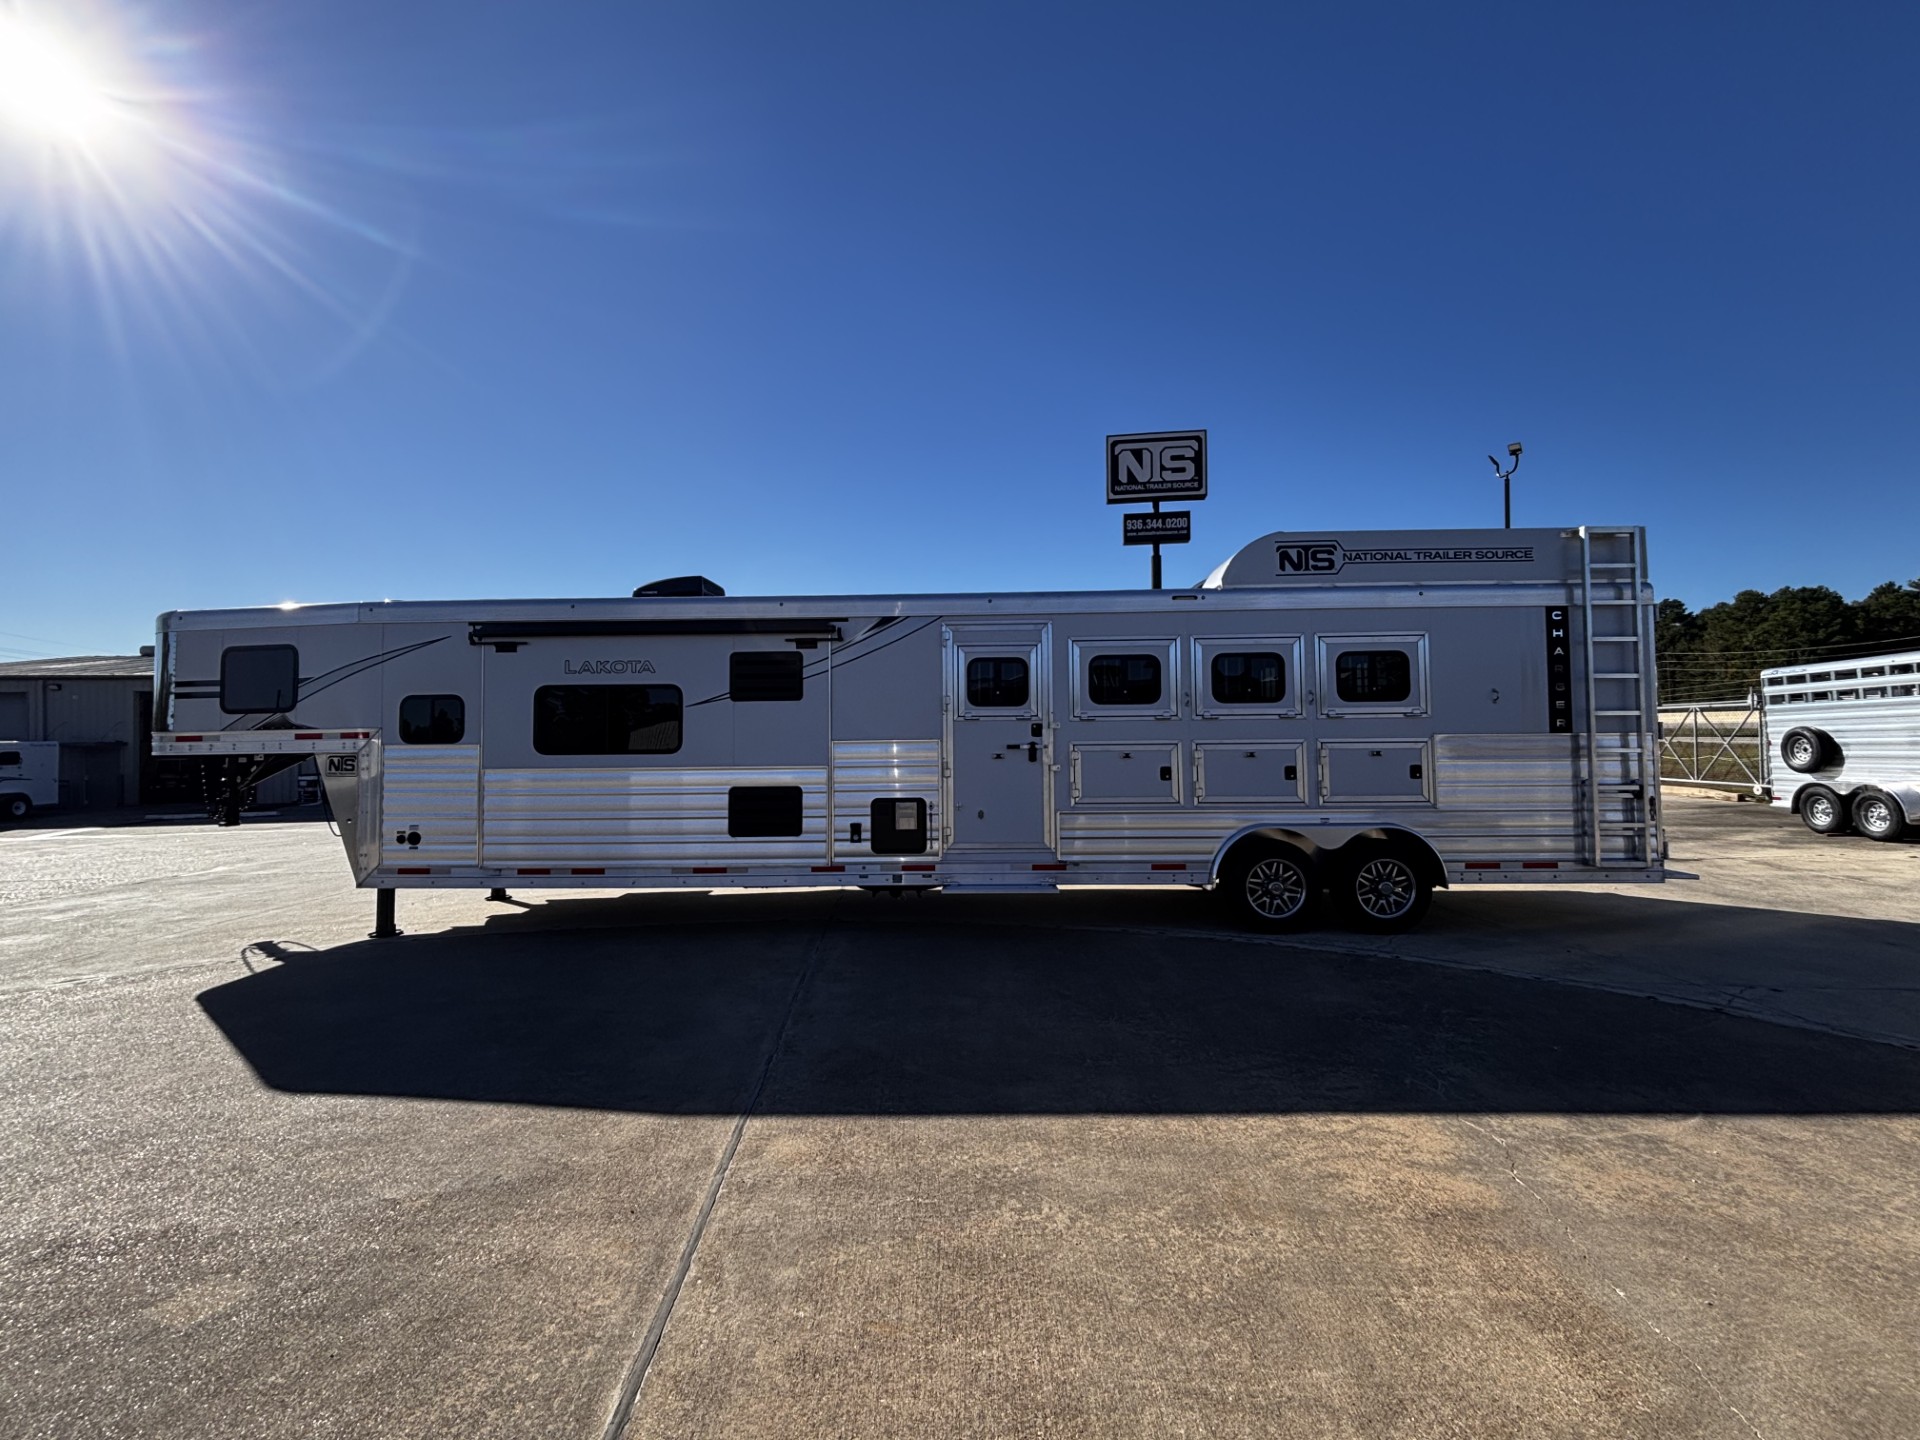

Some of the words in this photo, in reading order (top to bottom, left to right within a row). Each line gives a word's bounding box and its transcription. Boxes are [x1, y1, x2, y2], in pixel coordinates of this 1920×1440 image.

[1114, 440, 1199, 483] NTS
[1115, 483, 1145, 491] NATIONAL
[1146, 482, 1172, 490] TRAILER
[1126, 517, 1188, 530] 936.344.0200
[1275, 544, 1338, 572] NTS
[1342, 551, 1412, 561] NATIONAL
[1413, 551, 1472, 560] TRAILER
[1475, 550, 1534, 559] SOURCE
[564, 659, 656, 674] LAKOTA
[1551, 611, 1566, 727] CHARGER
[328, 755, 357, 772] NTS
